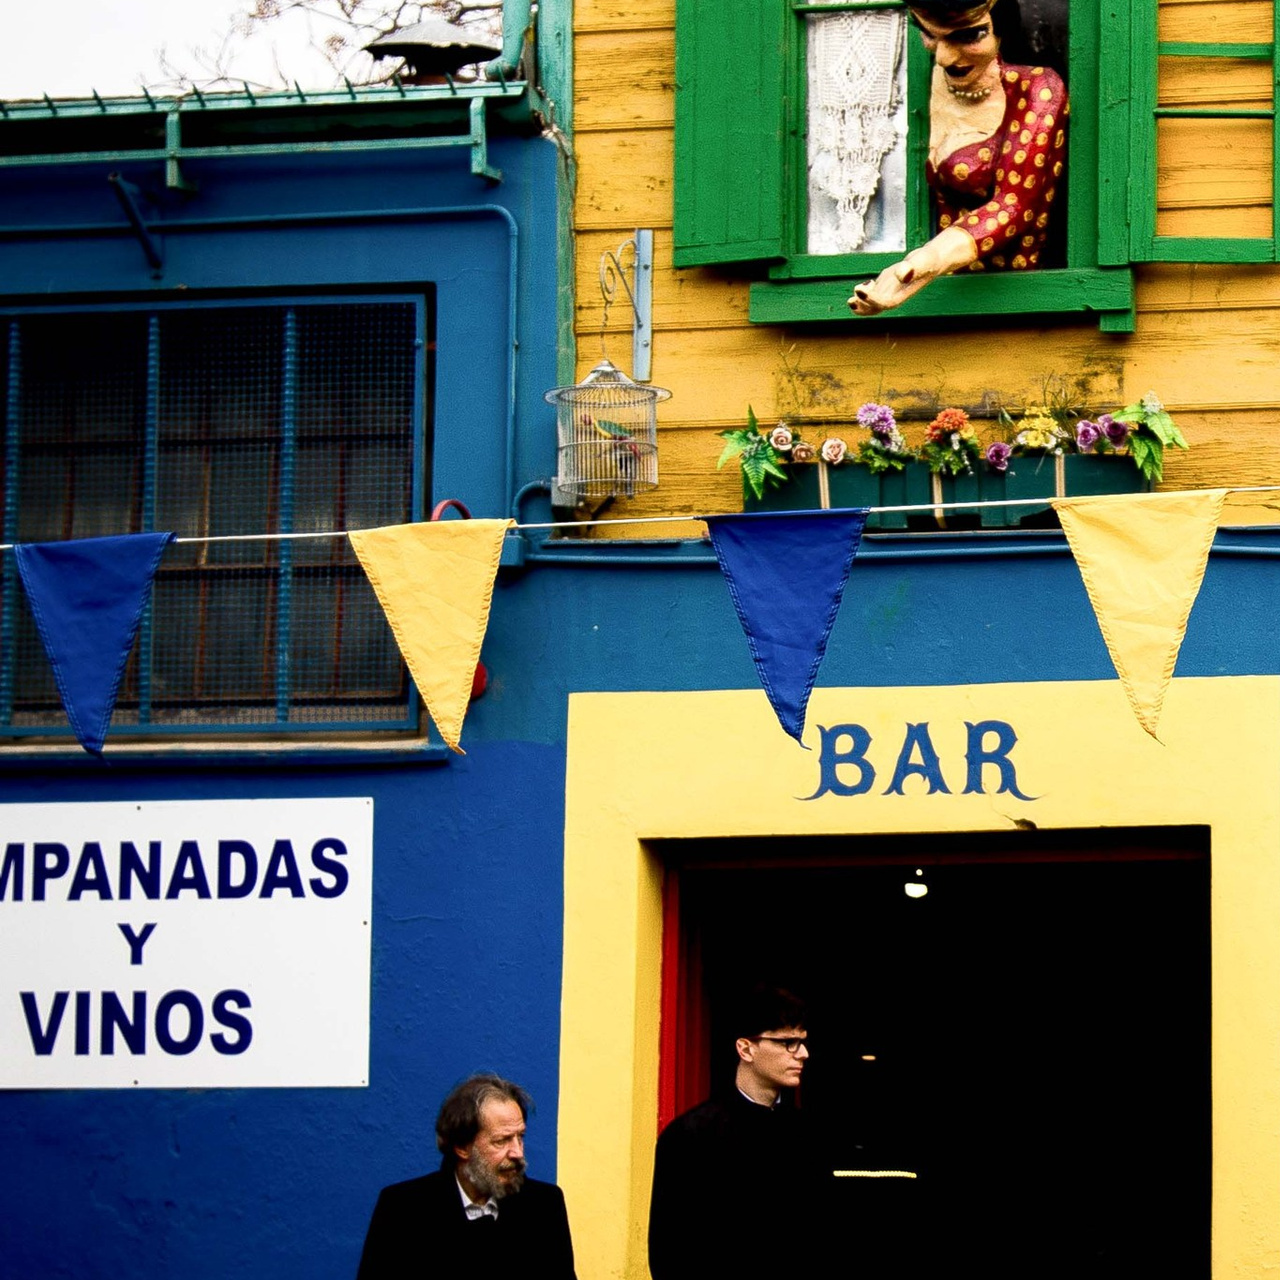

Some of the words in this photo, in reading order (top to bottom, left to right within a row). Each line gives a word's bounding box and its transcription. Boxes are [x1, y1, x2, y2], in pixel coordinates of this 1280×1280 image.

[793, 720, 1042, 801] BAR
[117, 922, 158, 966] Y
[19, 988, 254, 1056] VINOS
